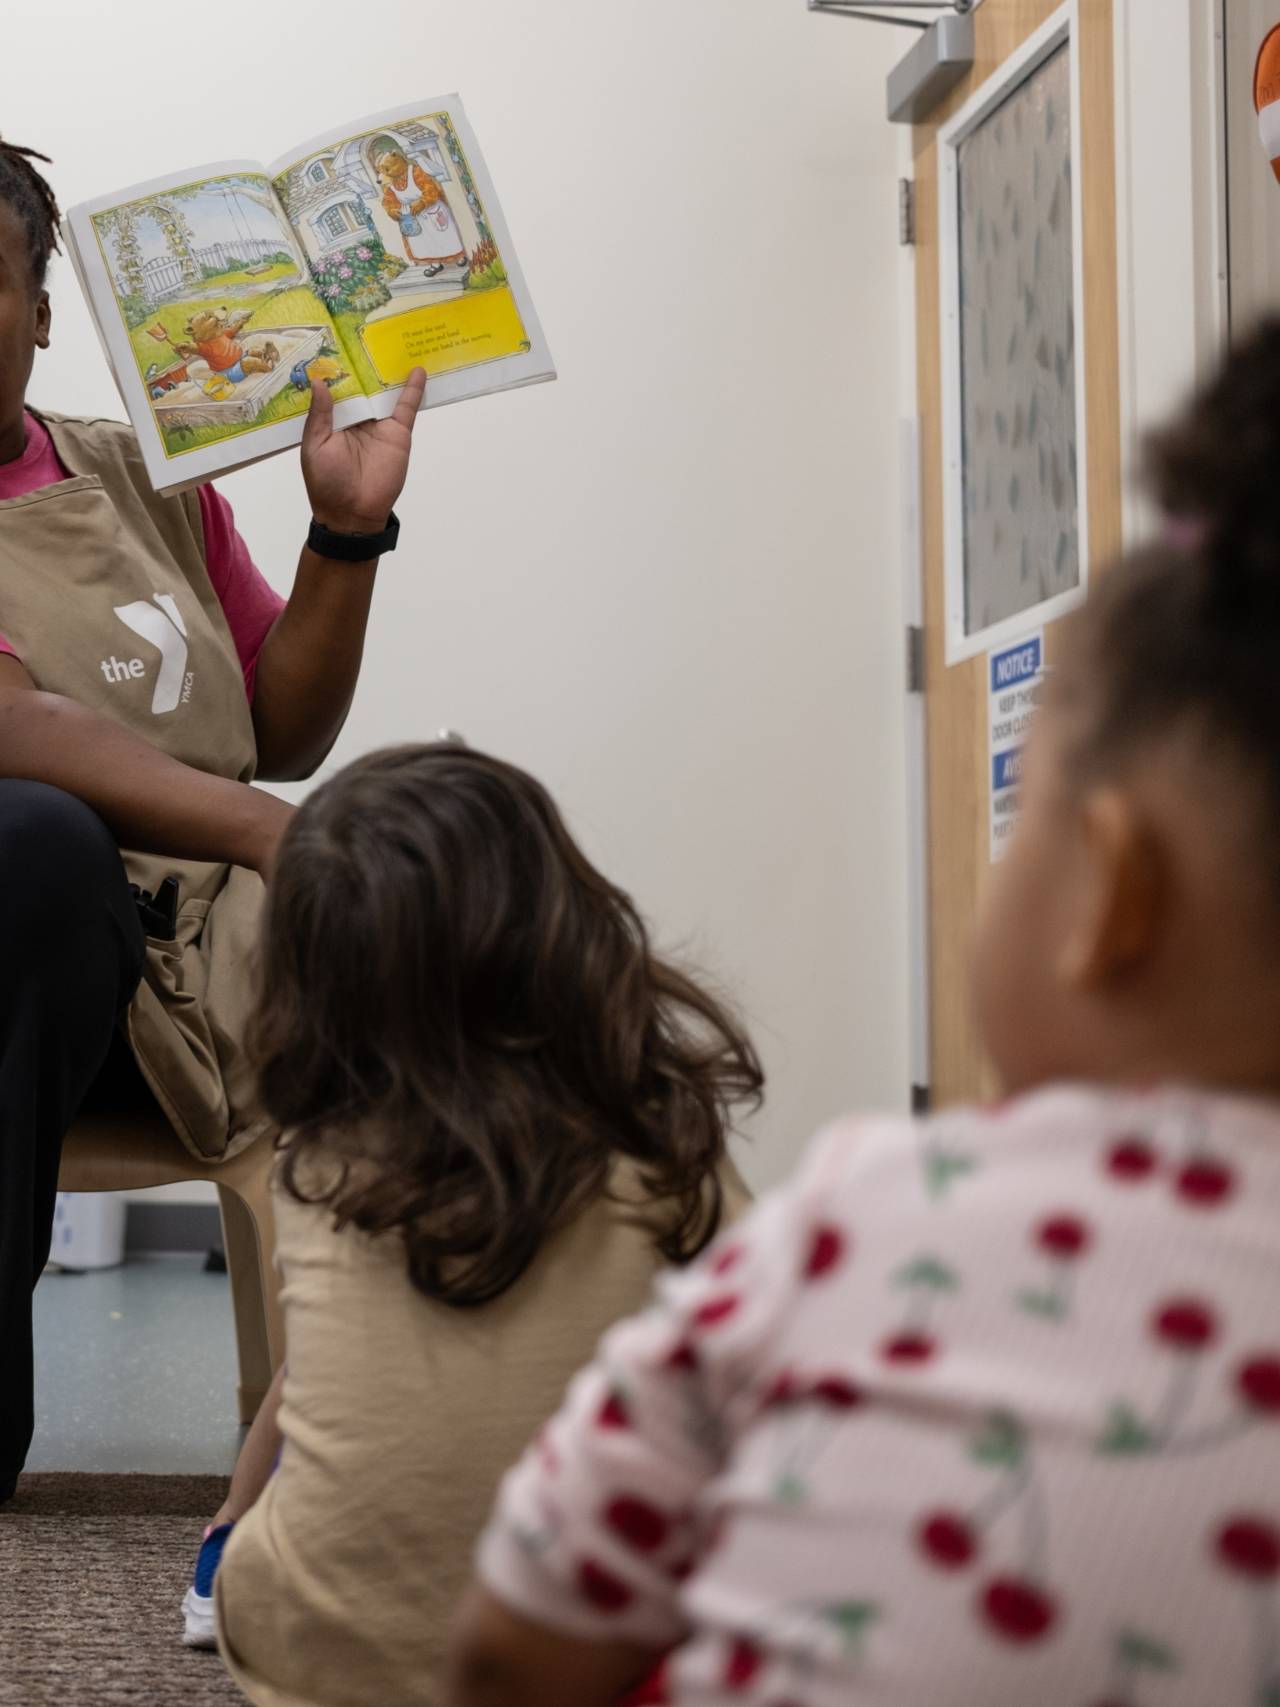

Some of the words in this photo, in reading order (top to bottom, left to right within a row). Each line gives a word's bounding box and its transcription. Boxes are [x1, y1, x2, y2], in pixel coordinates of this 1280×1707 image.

[100, 656, 145, 683] the
[997, 646, 1035, 684] NOTICE
[181, 672, 194, 703] YMCA
